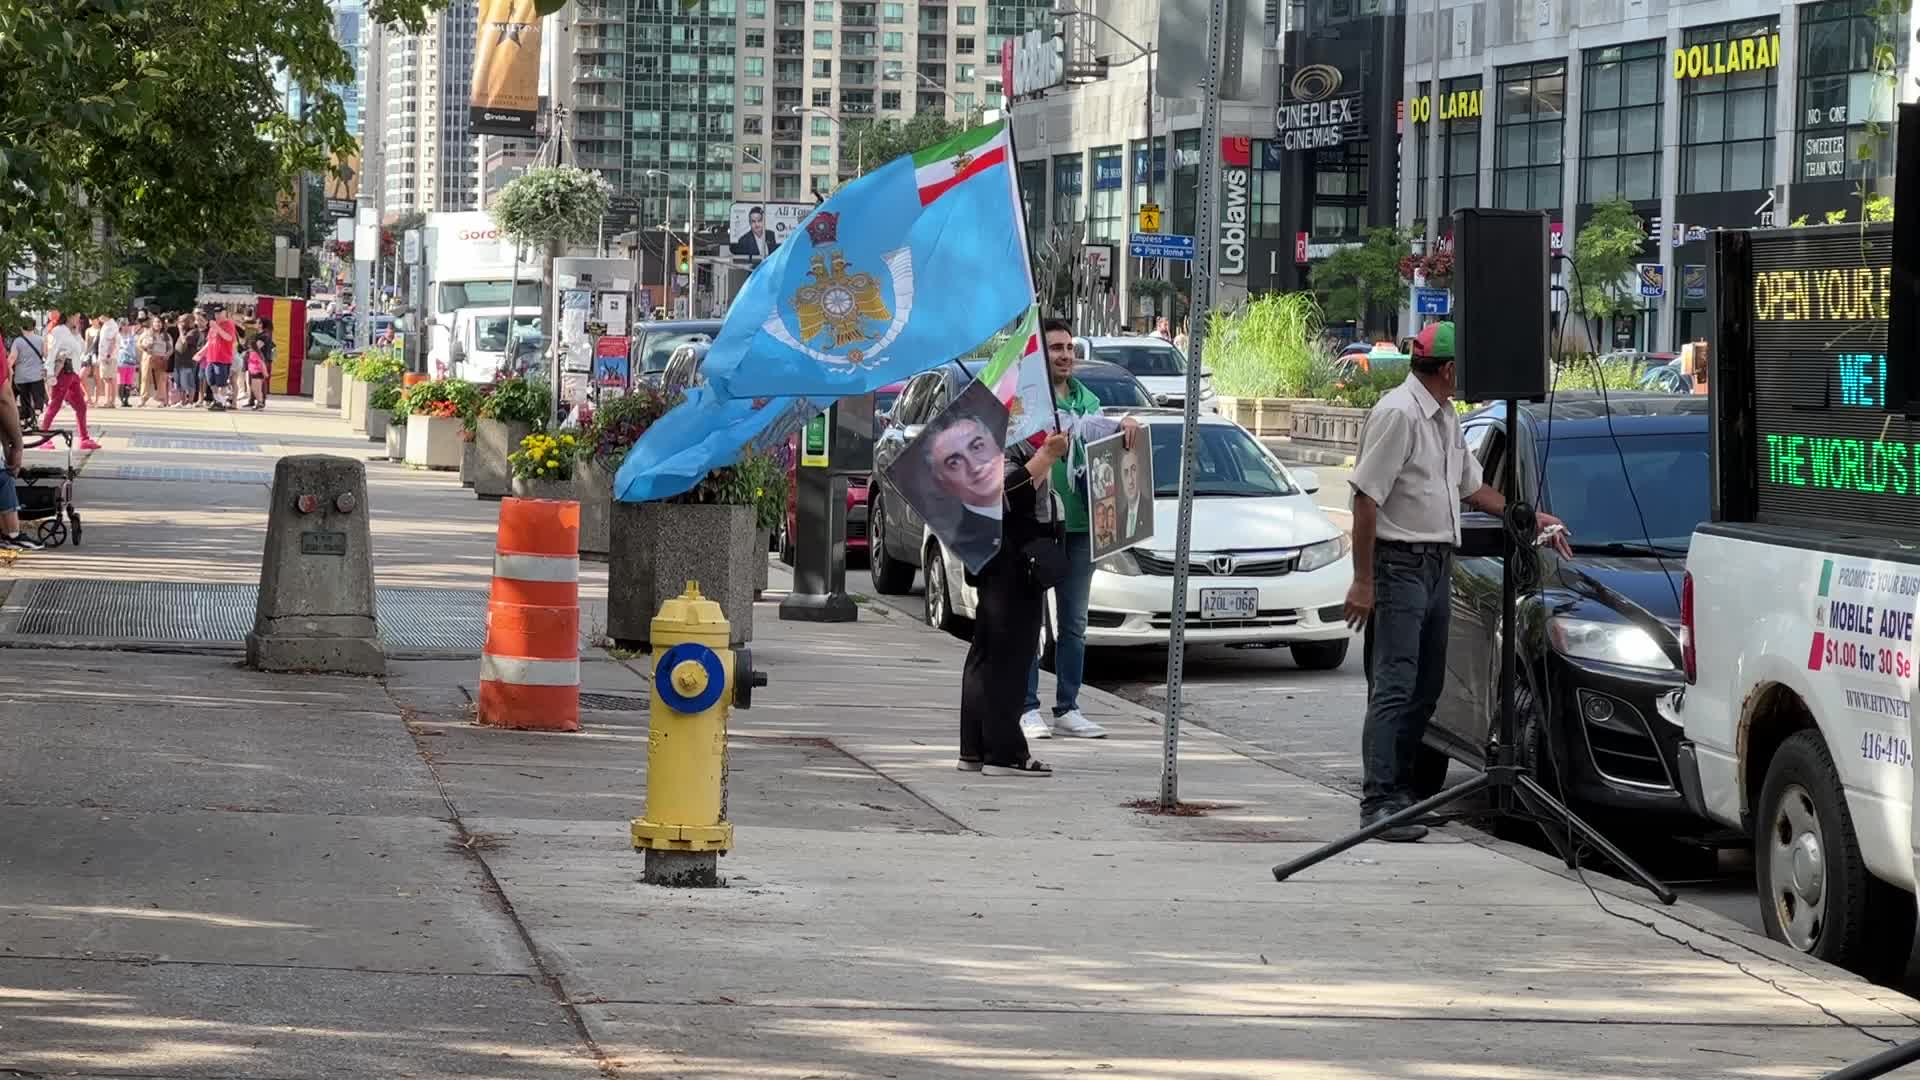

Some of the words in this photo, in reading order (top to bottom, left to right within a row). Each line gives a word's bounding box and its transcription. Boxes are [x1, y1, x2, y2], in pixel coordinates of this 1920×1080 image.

[1276, 98, 1352, 129] CINEPLEX
[1284, 125, 1341, 151] CINEMAS
[1806, 136, 1844, 155] SWEETER
[1220, 169, 1247, 275] Loblaws
[1132, 234, 1162, 244] Empress
[1144, 247, 1161, 255] Park
[1163, 249, 1184, 257] Home
[1642, 286, 1661, 295] RBC
[1754, 271, 1810, 320] OPEN
[1813, 268, 1876, 319] YOUR
[1838, 354, 1873, 406] WE
[1767, 434, 1806, 484] THE
[1808, 437, 1908, 494] WORLD'S
[1838, 567, 1876, 591] PROMOTE
[1877, 571, 1899, 594] YOUR
[1829, 600, 1874, 635] MOBILE
[1825, 638, 1857, 669] $1.00
[1859, 644, 1876, 673] for
[1878, 648, 1893, 675] 30
